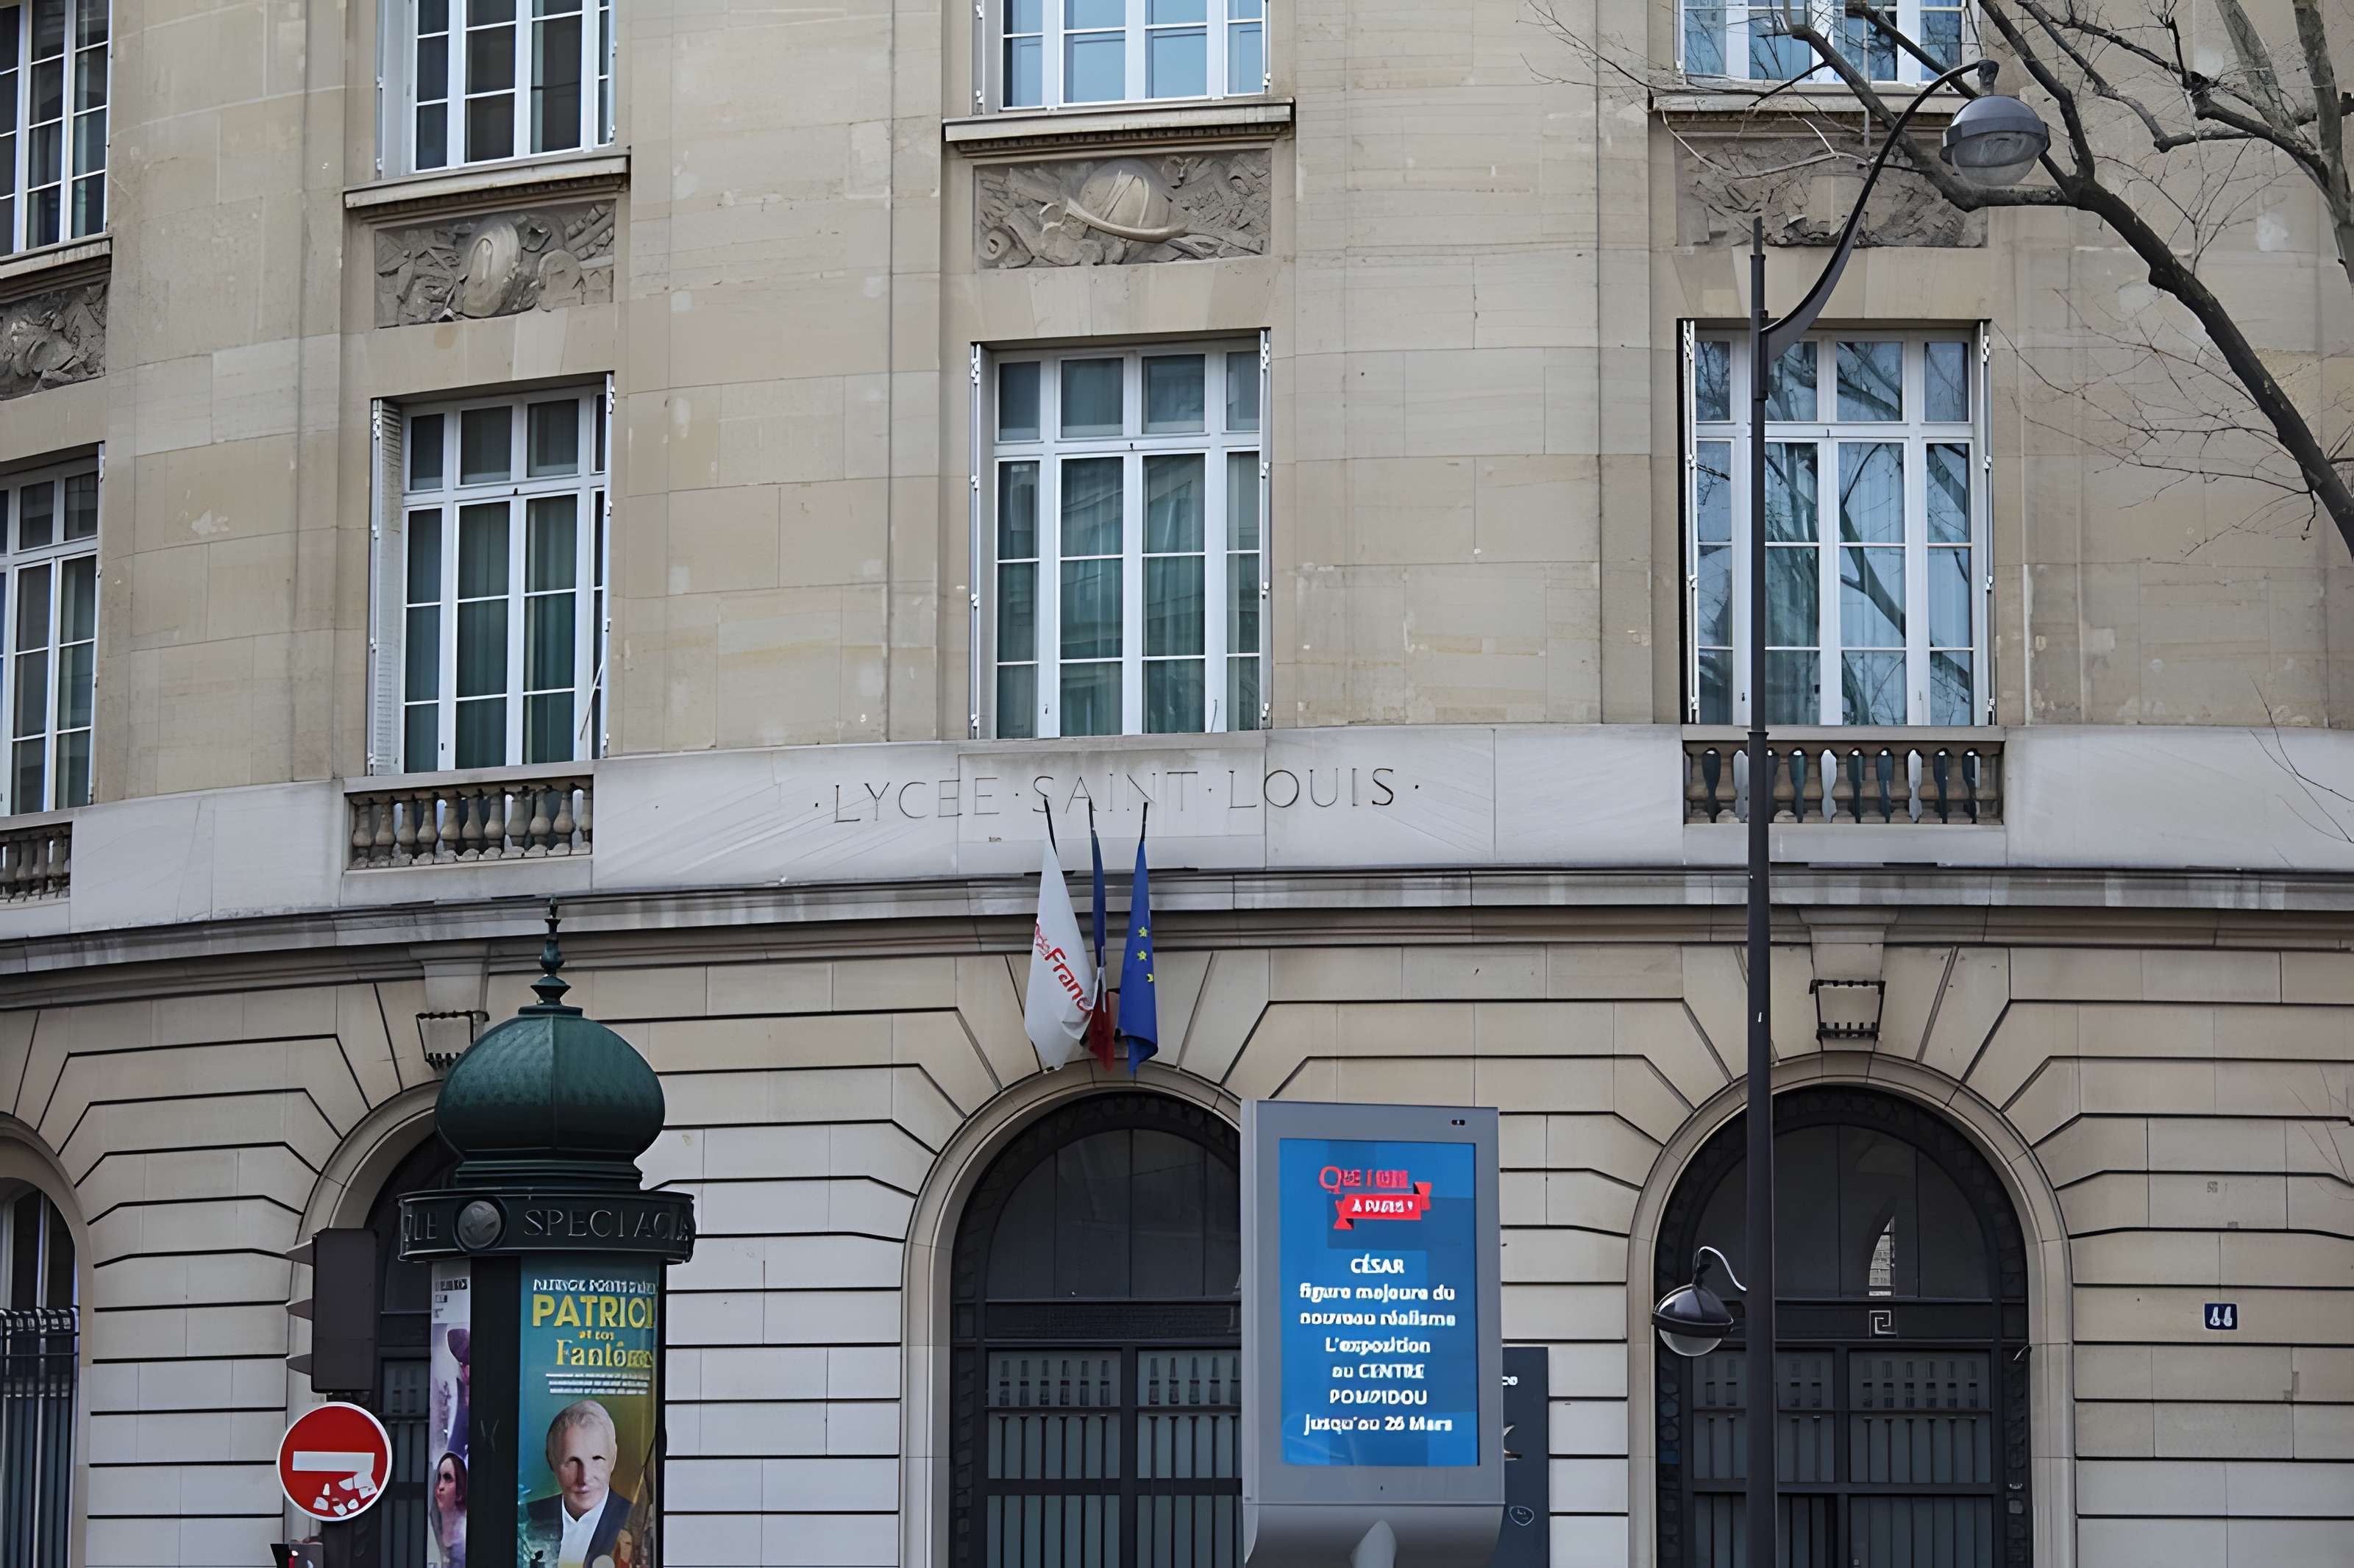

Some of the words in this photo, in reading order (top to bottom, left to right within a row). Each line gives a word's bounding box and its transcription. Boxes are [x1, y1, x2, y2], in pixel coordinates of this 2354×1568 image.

[834, 777, 1000, 824] LYCEE
[1031, 770, 1198, 814] SAINT
[1228, 767, 1395, 810] LOUIS
[1044, 947, 1094, 1021] Franc
[1350, 1253, 1405, 1274] CÉSAR
[1300, 1283, 1351, 1303] figure
[1356, 1283, 1429, 1303] majeure
[1433, 1284, 1456, 1300] du
[1300, 1312, 1376, 1325] nouveau
[1325, 1336, 1431, 1355] L'exposition
[1359, 1364, 1425, 1379] CENTRE
[1329, 1389, 1428, 1405] POMPIDOU
[1409, 1416, 1453, 1431] Mars
